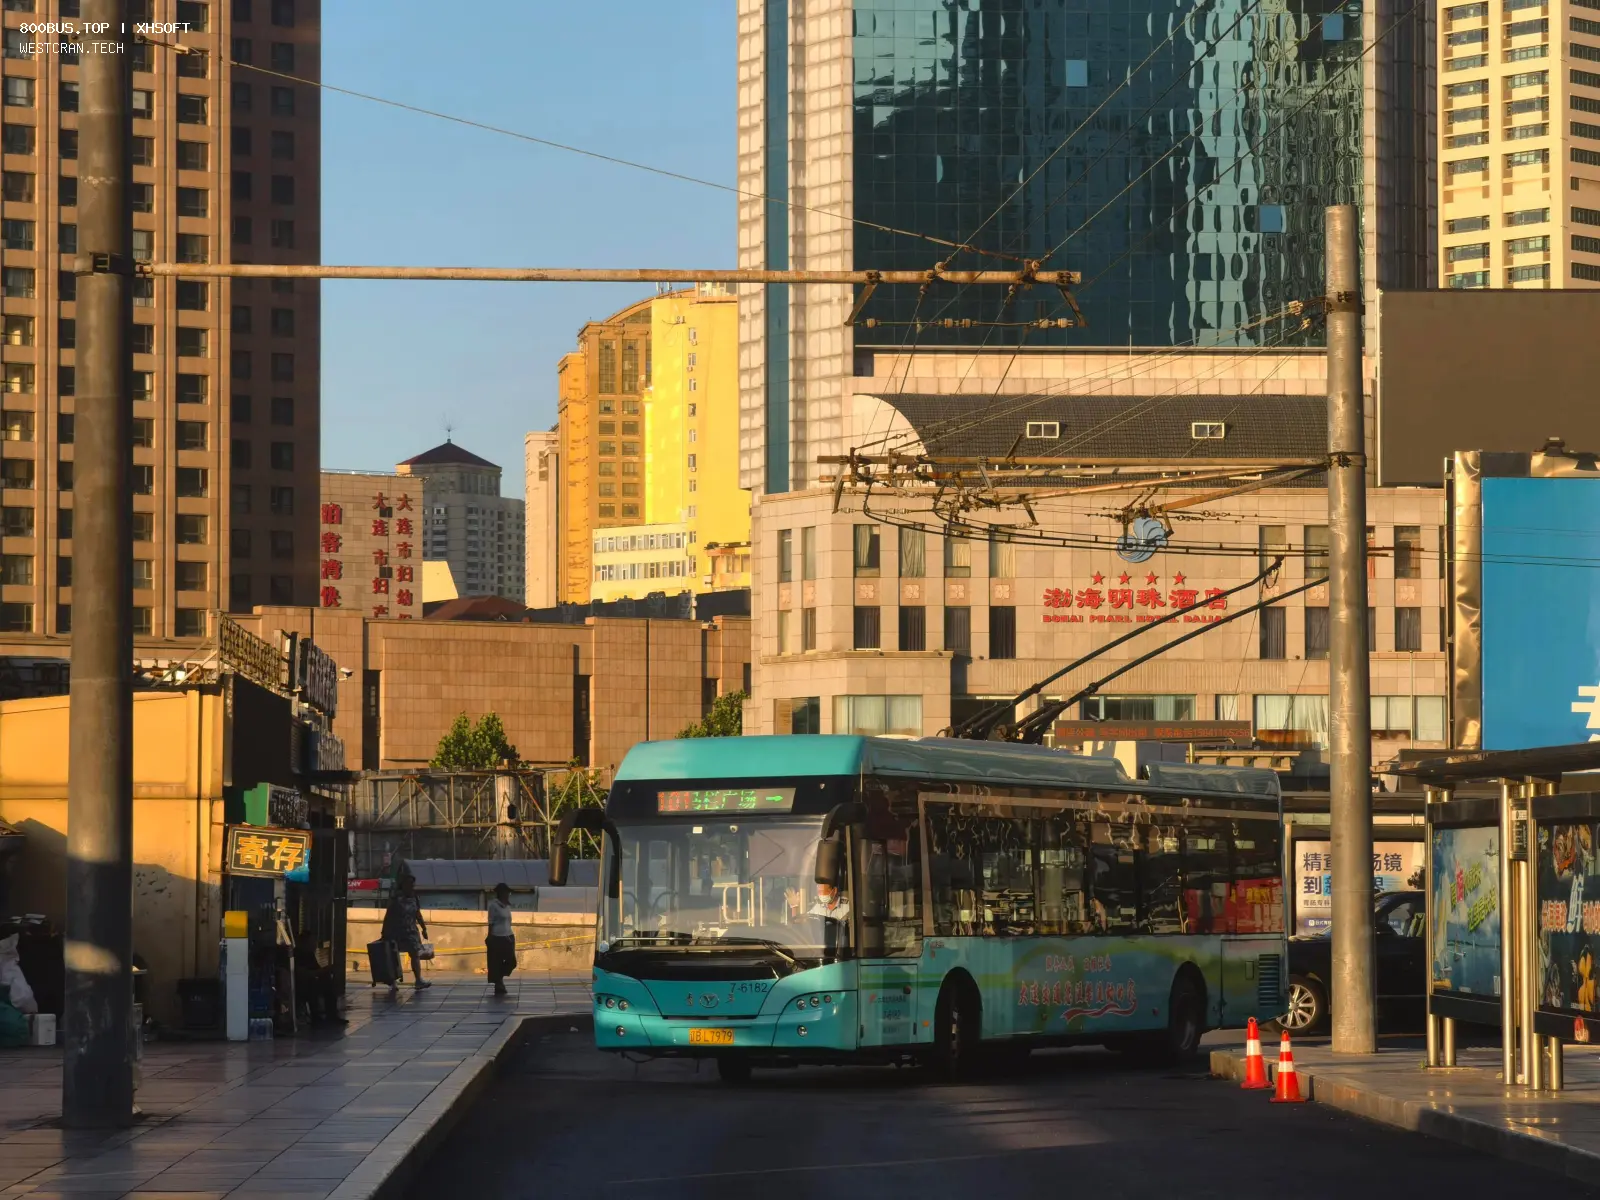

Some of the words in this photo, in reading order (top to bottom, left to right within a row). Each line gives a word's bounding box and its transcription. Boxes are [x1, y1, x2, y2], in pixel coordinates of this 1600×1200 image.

[1042, 587, 1229, 610] 渤海明珠酒店
[1042, 614, 1084, 623] BOHAI
[1089, 614, 1133, 623] PEARL
[236, 835, 303, 871] 寄存
[730, 982, 769, 994] 7-6182
